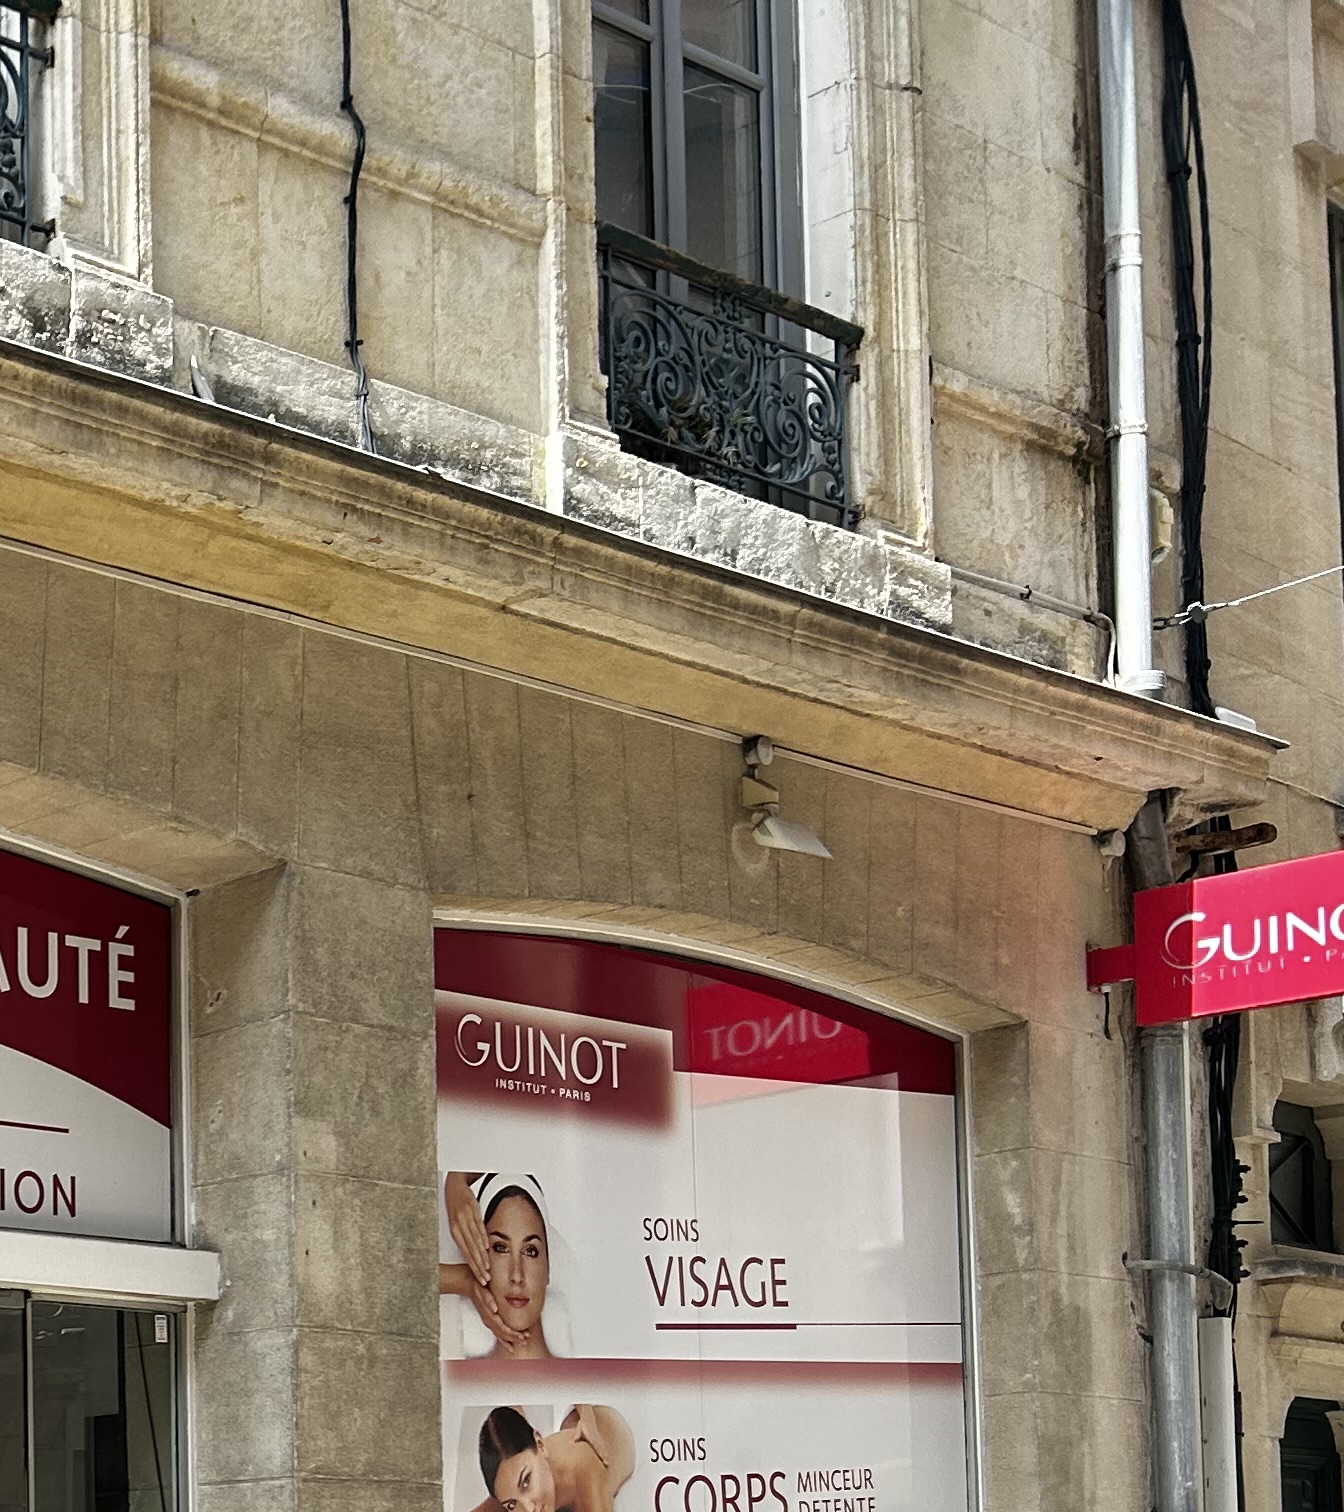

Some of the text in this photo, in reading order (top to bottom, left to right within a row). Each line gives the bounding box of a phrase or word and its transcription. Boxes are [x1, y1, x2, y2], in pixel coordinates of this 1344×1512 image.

[1173, 957, 1286, 988] INSTITUT
[454, 1013, 627, 1089] GUINOT
[495, 1077, 592, 1103] INSTITUT PARIS
[643, 1217, 700, 1243] SOINS
[645, 1255, 789, 1309] VISAGE
[649, 1437, 707, 1463] SOINS
[797, 1468, 875, 1493] MINCEUR
